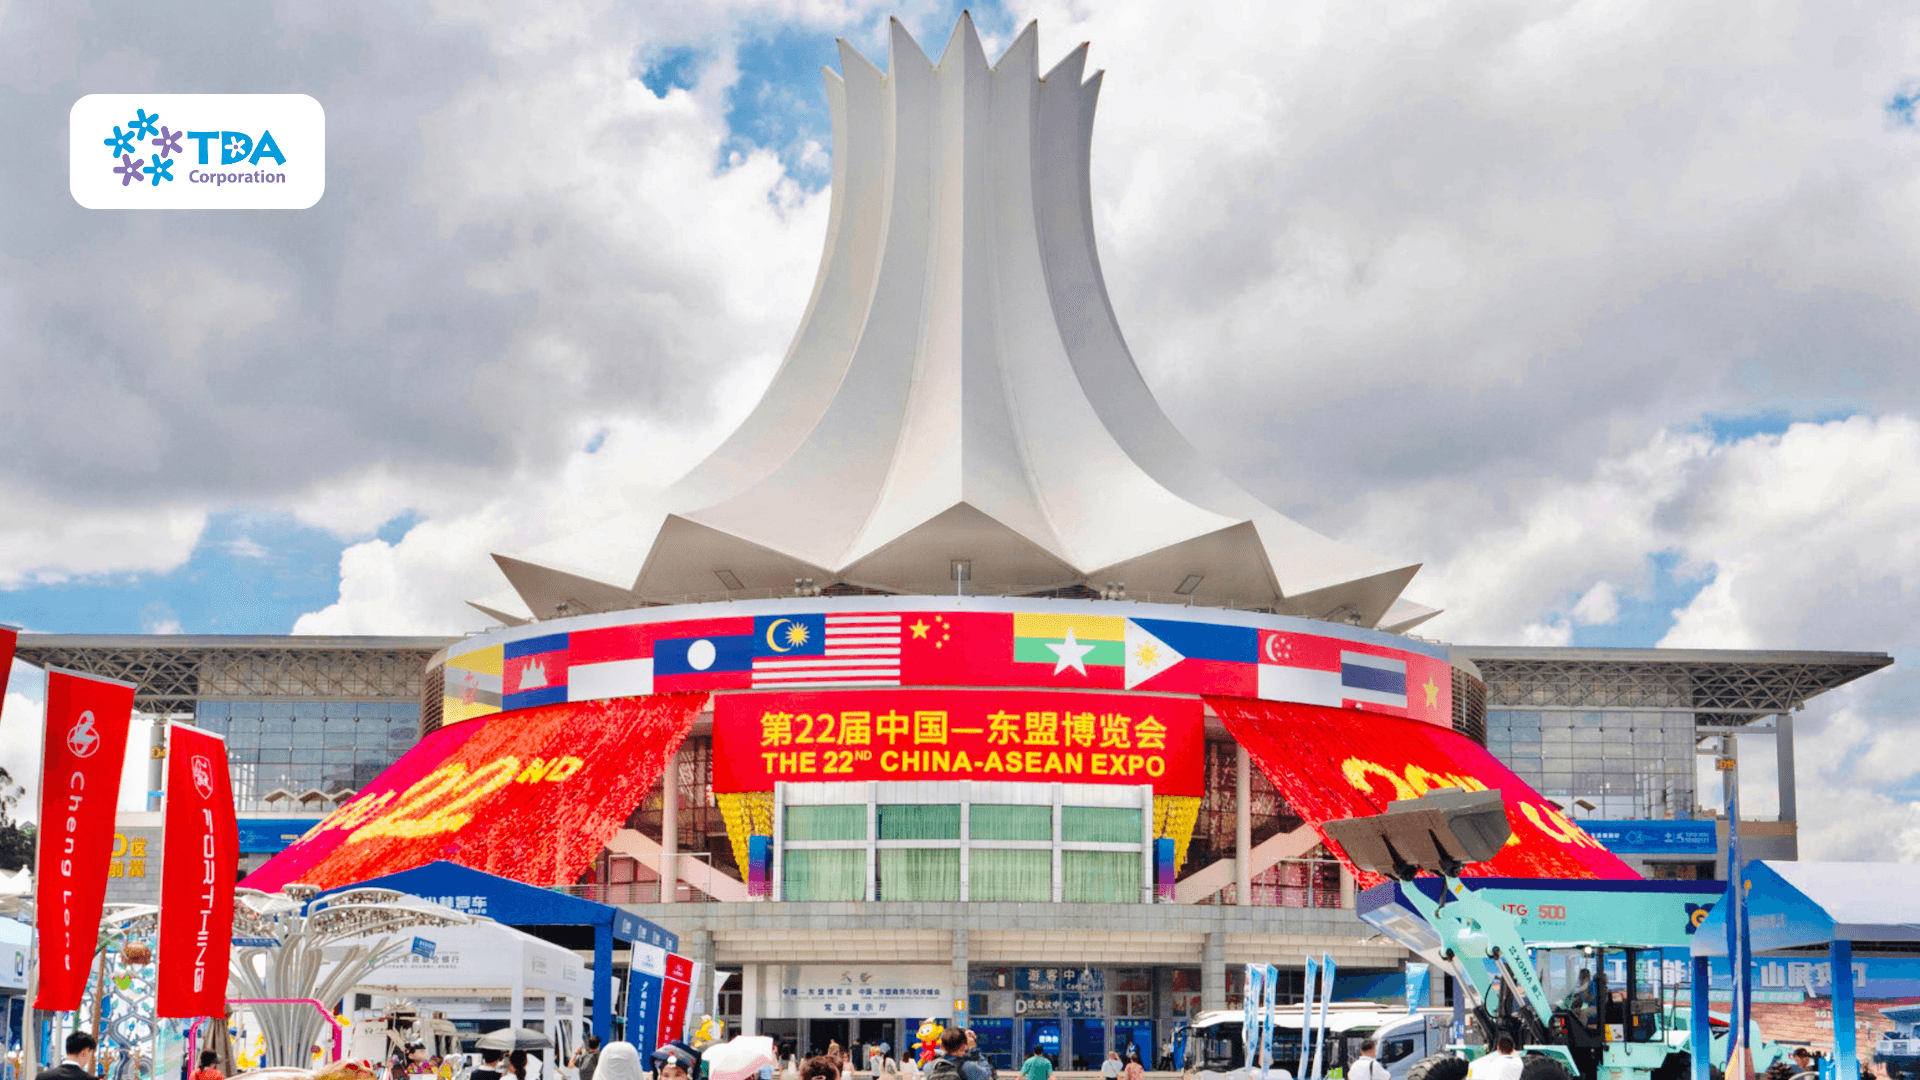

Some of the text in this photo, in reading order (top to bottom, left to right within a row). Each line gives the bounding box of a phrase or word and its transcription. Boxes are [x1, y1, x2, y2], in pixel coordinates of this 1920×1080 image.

[761, 752, 816, 774] THE
[880, 751, 1083, 775] CHINA-ASEAN
[1091, 754, 1166, 778] EXPO
[61, 771, 85, 877] Cheng
[194, 808, 215, 993] FORTHING
[1538, 905, 1567, 920] 500
